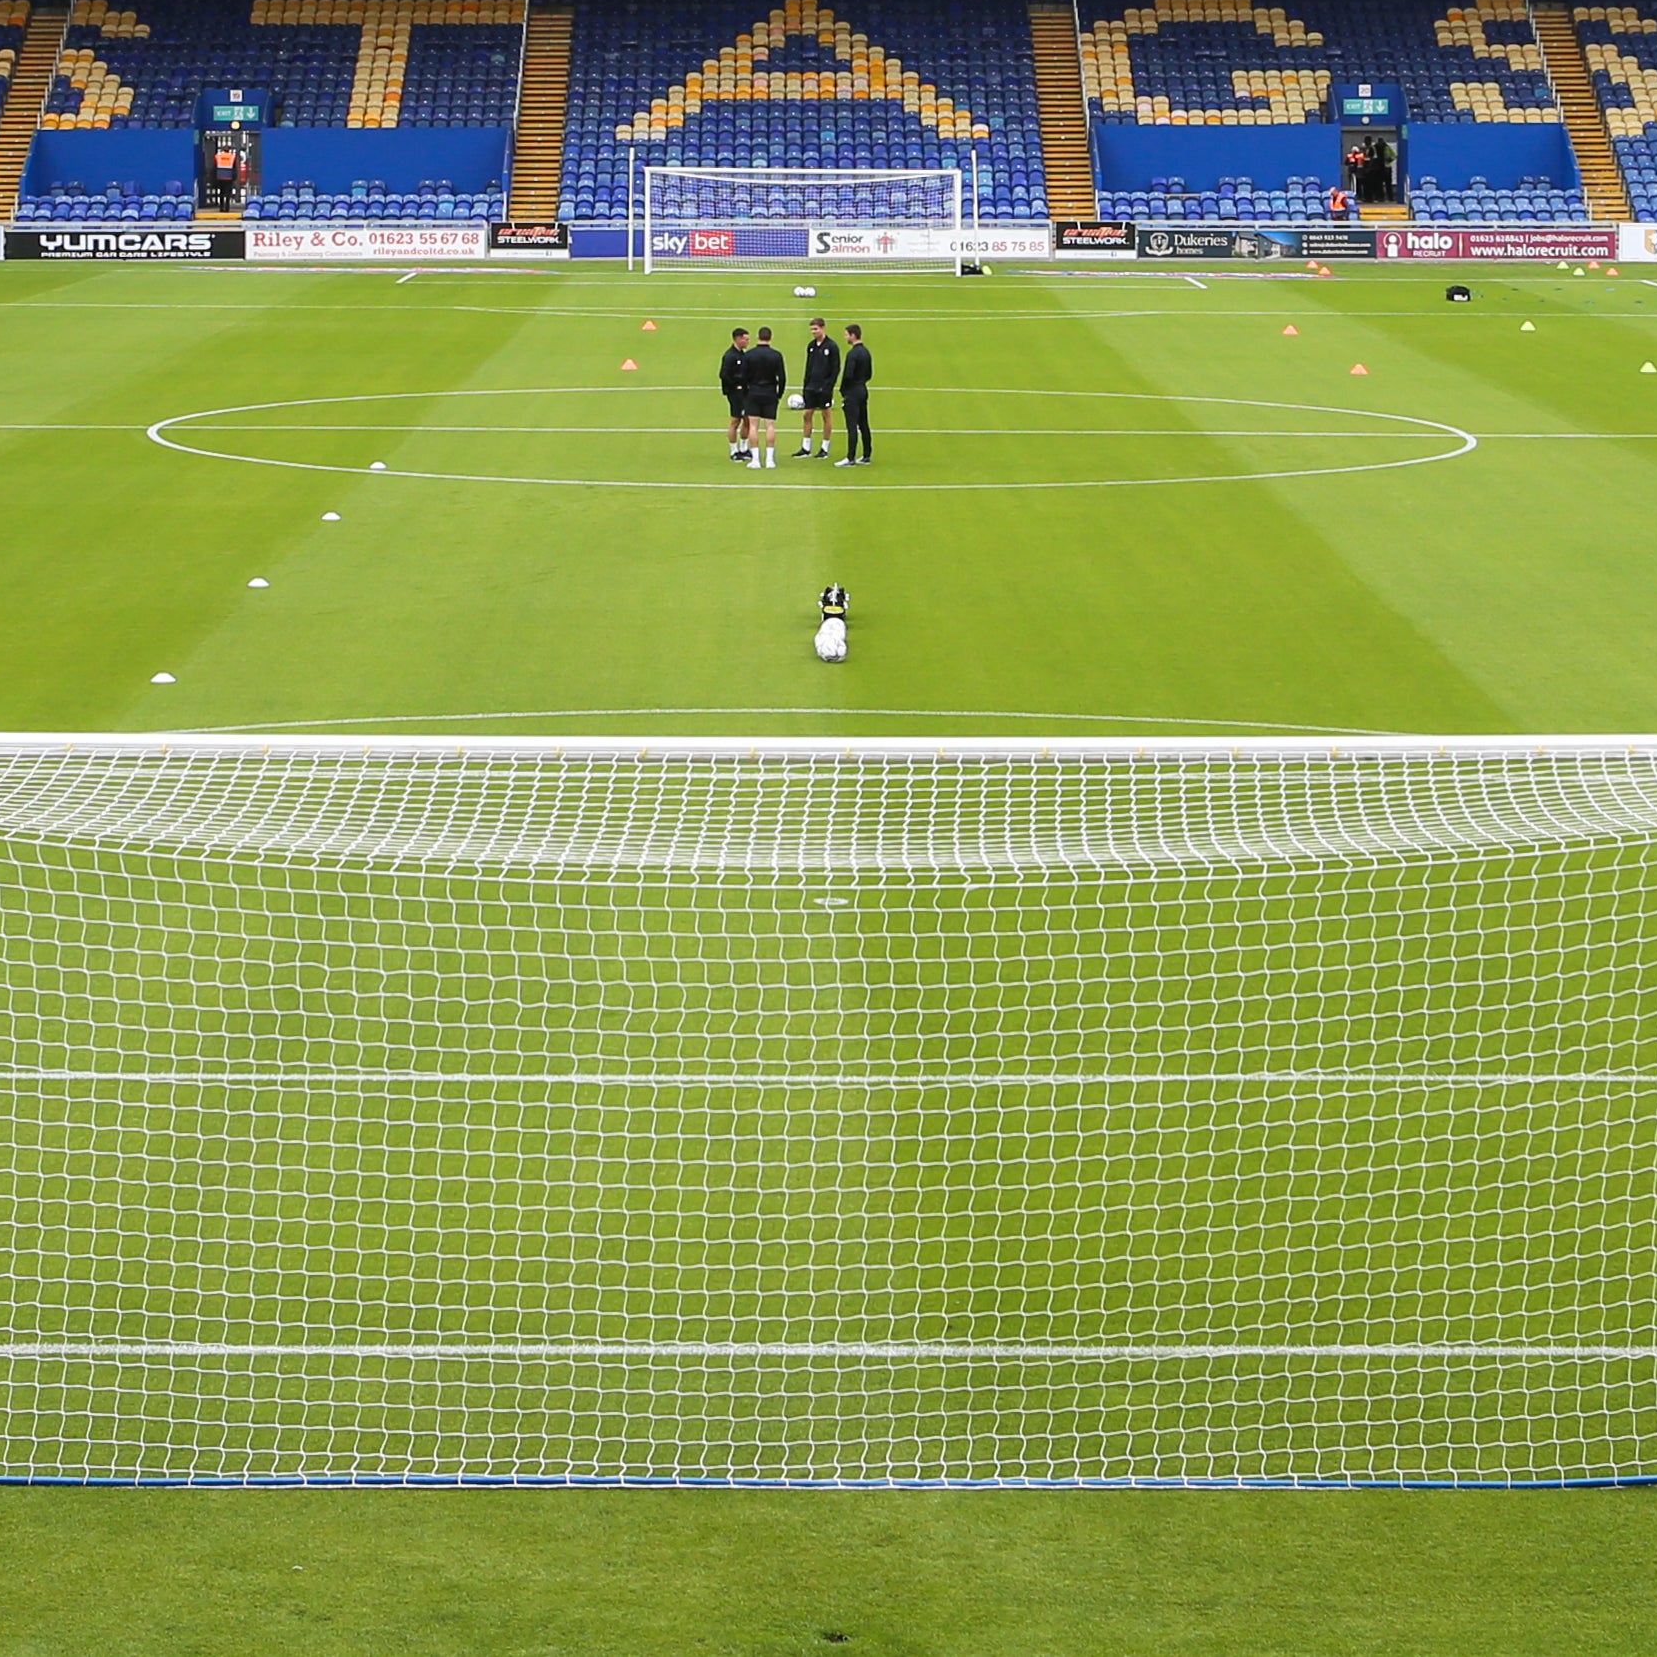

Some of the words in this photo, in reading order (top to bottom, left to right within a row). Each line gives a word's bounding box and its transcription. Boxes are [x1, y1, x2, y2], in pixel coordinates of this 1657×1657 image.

[39, 234, 211, 251] YUMCARS
[253, 231, 303, 251] Riley
[310, 232, 325, 247] &
[331, 231, 364, 247] Co.
[368, 232, 414, 245] 01623
[419, 233, 437, 245] 55
[441, 233, 460, 245] 67
[461, 233, 480, 245] 68
[652, 231, 688, 254] sky
[694, 234, 730, 251] bet
[992, 241, 1009, 252] 85
[1011, 241, 1027, 252] 75
[1029, 240, 1045, 252] 85
[1174, 234, 1229, 247] Dukeries
[1407, 232, 1453, 250] halo
[373, 247, 476, 256] rileyandcoltd.co.uk
[1176, 247, 1204, 255] homes
[1413, 250, 1446, 258] RECRUIT
[1470, 245, 1609, 258] www.halorecruit.com
